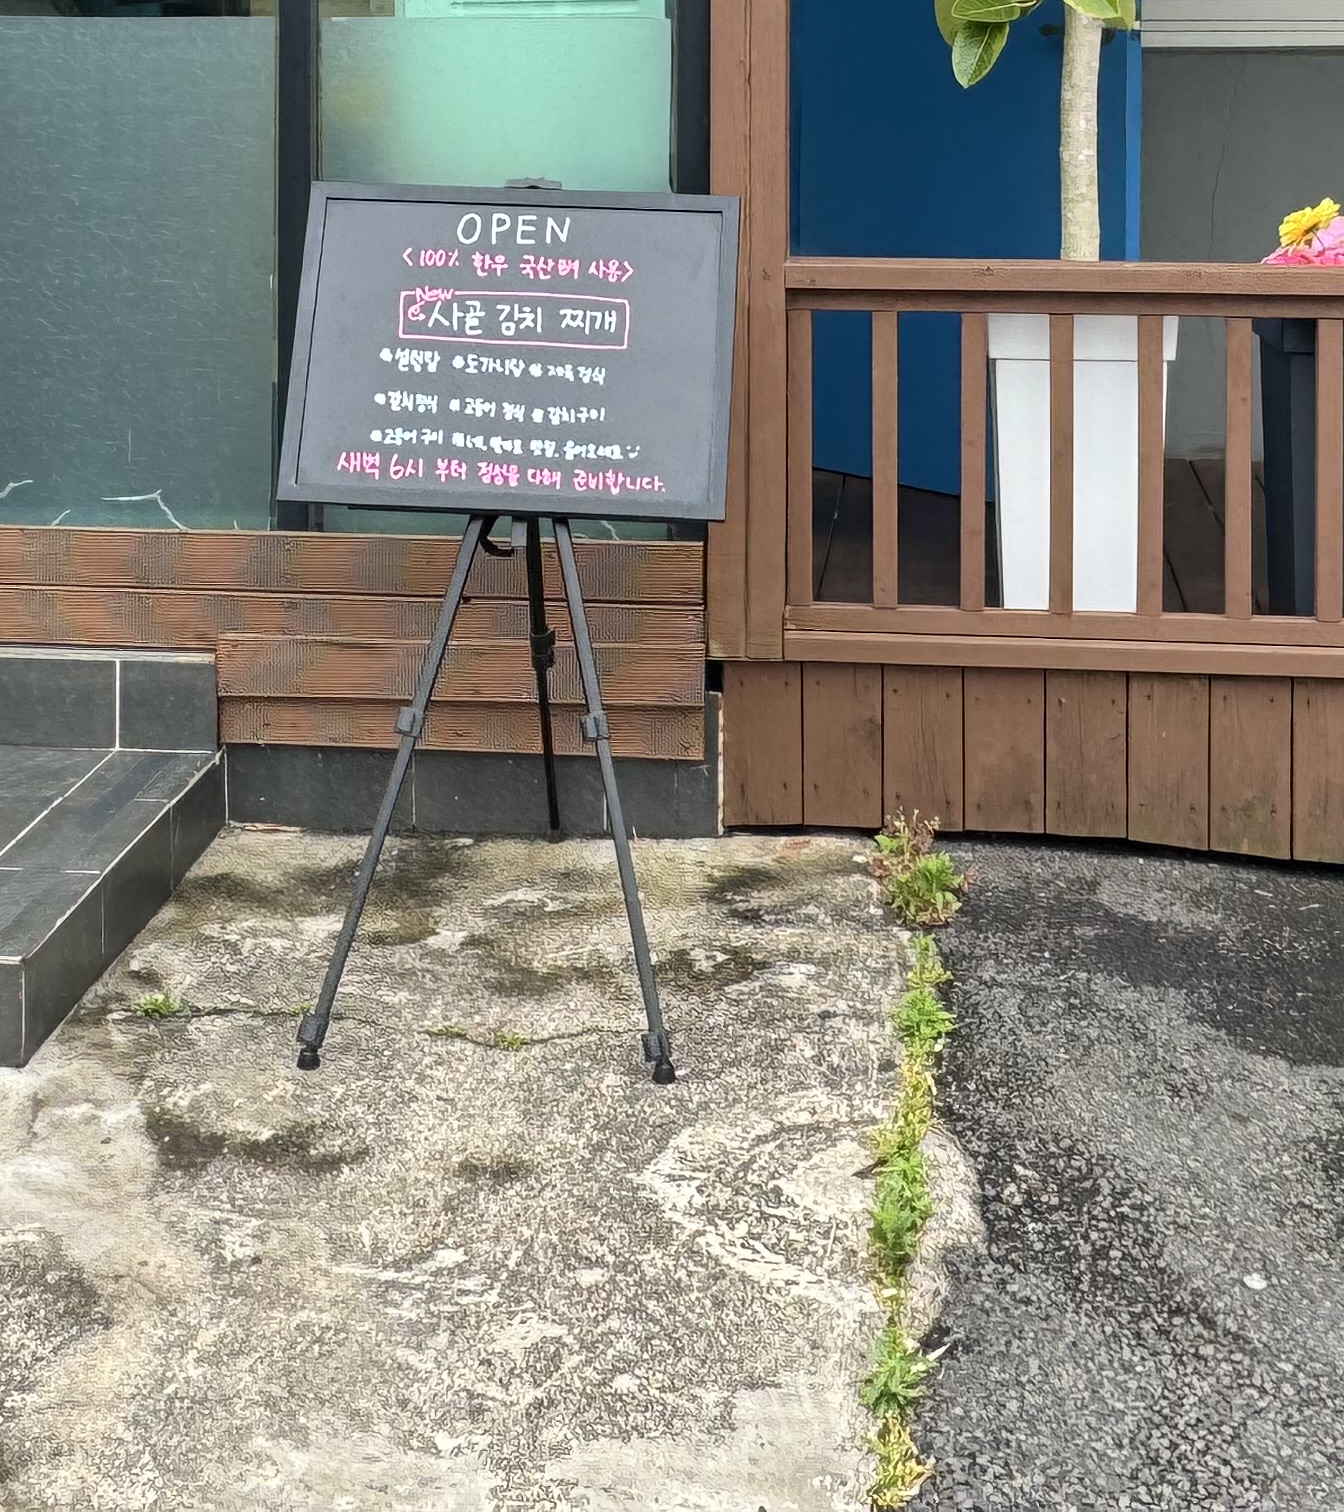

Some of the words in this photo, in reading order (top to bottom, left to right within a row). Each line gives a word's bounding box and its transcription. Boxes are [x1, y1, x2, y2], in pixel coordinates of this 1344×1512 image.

[456, 212, 571, 245] OPEN
[471, 251, 509, 277] 한우
[427, 300, 486, 335] 사골
[495, 303, 543, 336] 김치
[559, 308, 617, 335] 찌개
[336, 451, 380, 481] 새벽
[389, 453, 424, 480] 6시
[434, 457, 467, 483] 부터
[527, 467, 562, 490] 다해
